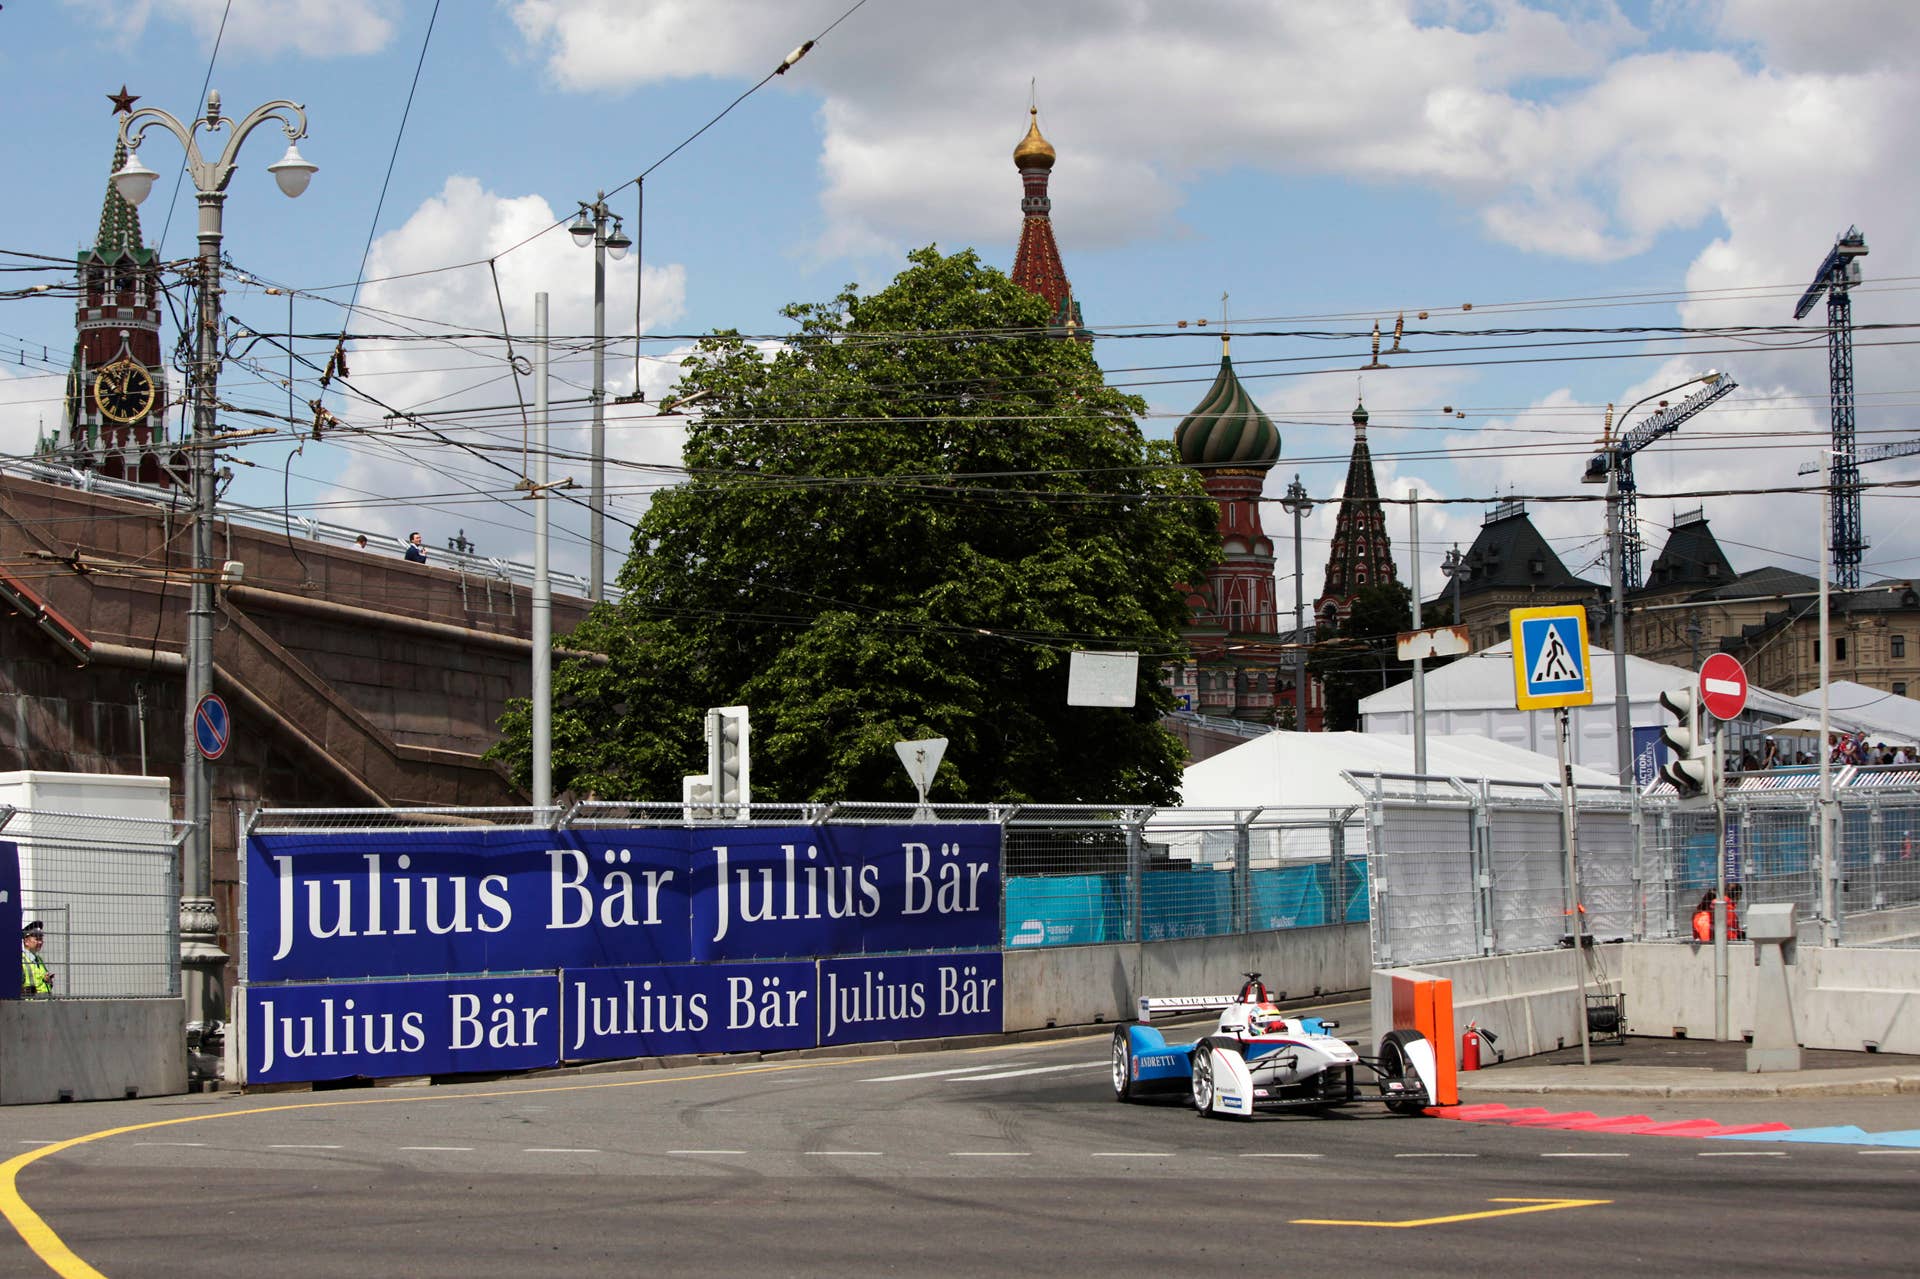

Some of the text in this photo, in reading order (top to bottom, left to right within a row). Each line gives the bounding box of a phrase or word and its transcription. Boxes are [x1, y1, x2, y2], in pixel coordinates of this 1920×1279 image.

[1639, 754, 1647, 785] ACTION
[712, 842, 989, 942] Julius Bär
[1726, 849, 1736, 877] Julius
[273, 848, 675, 961] Julius Bär
[259, 993, 549, 1074] Julius Bär
[573, 975, 808, 1050] Julius Bär
[827, 965, 997, 1037] Julius Bär
[1159, 996, 1237, 1006] ANDRETTI
[1140, 1055, 1175, 1068] ANDRETTI
